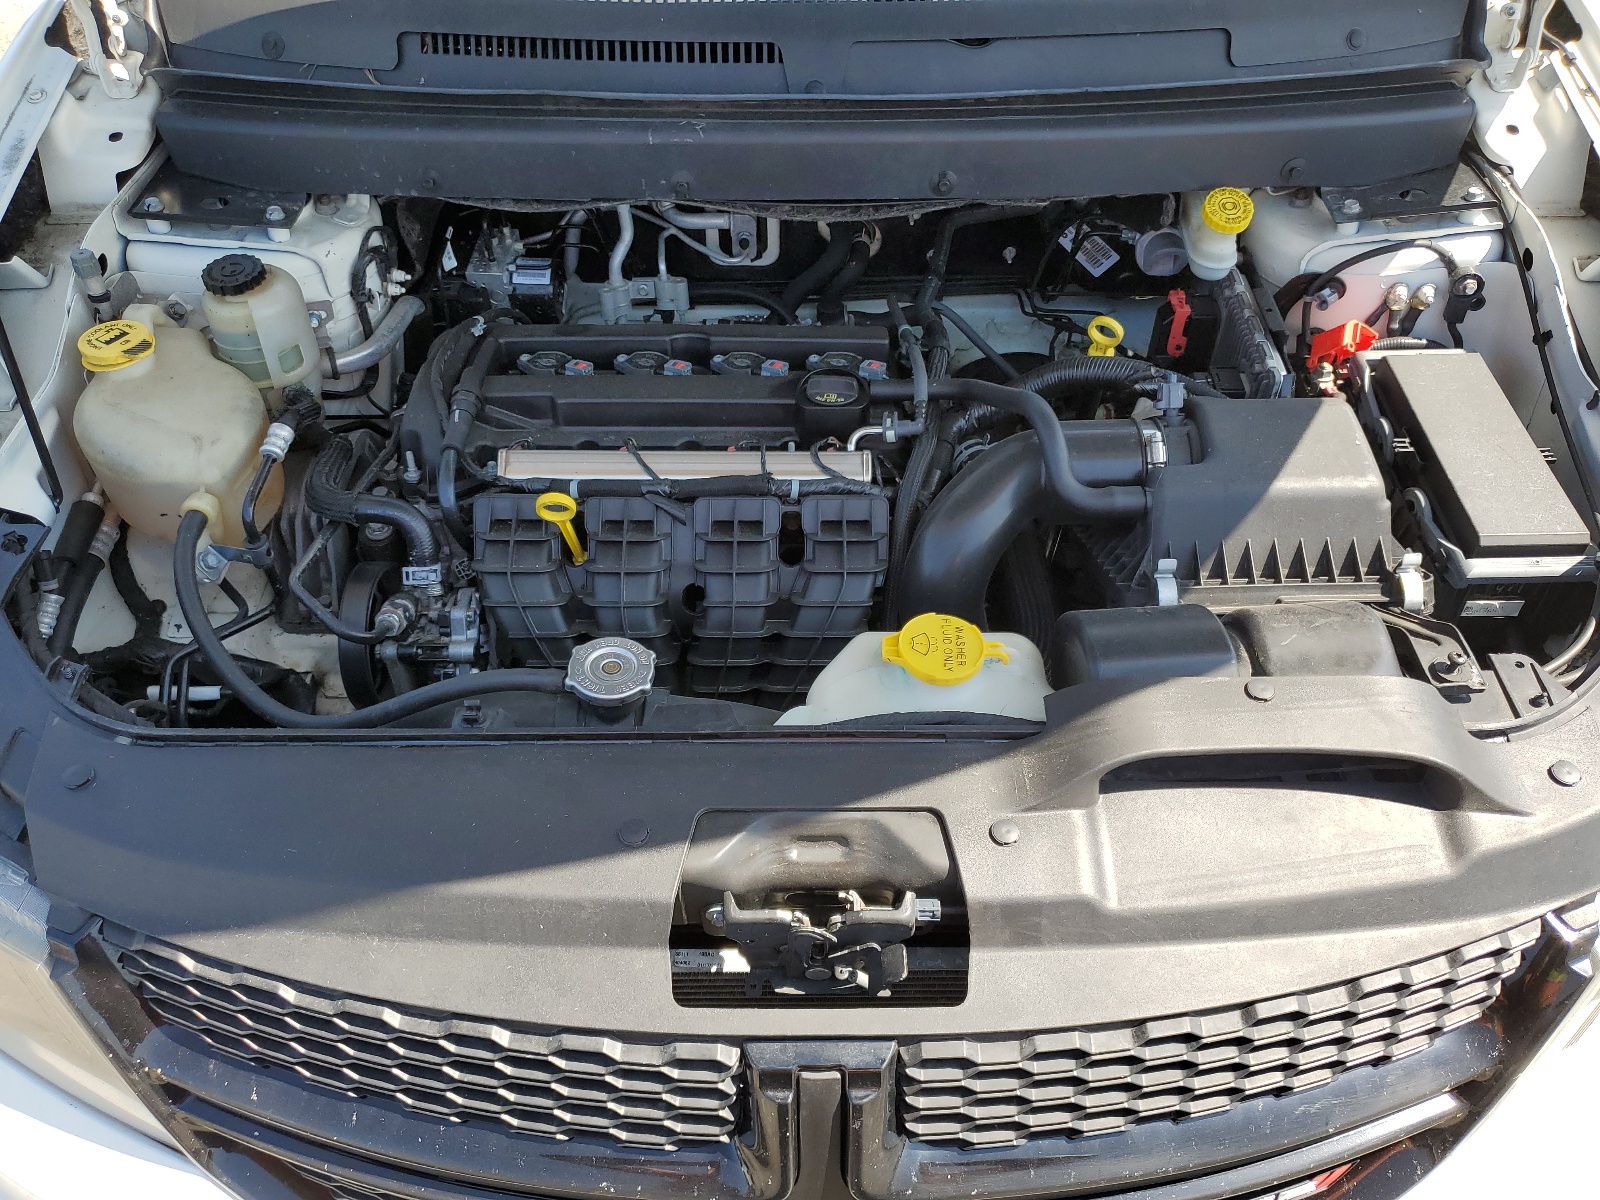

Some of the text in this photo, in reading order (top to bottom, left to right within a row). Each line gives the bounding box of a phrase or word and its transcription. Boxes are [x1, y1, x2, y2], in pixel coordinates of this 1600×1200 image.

[941, 618, 955, 672] FLUID ONLY
[955, 625, 968, 667] WASHER
